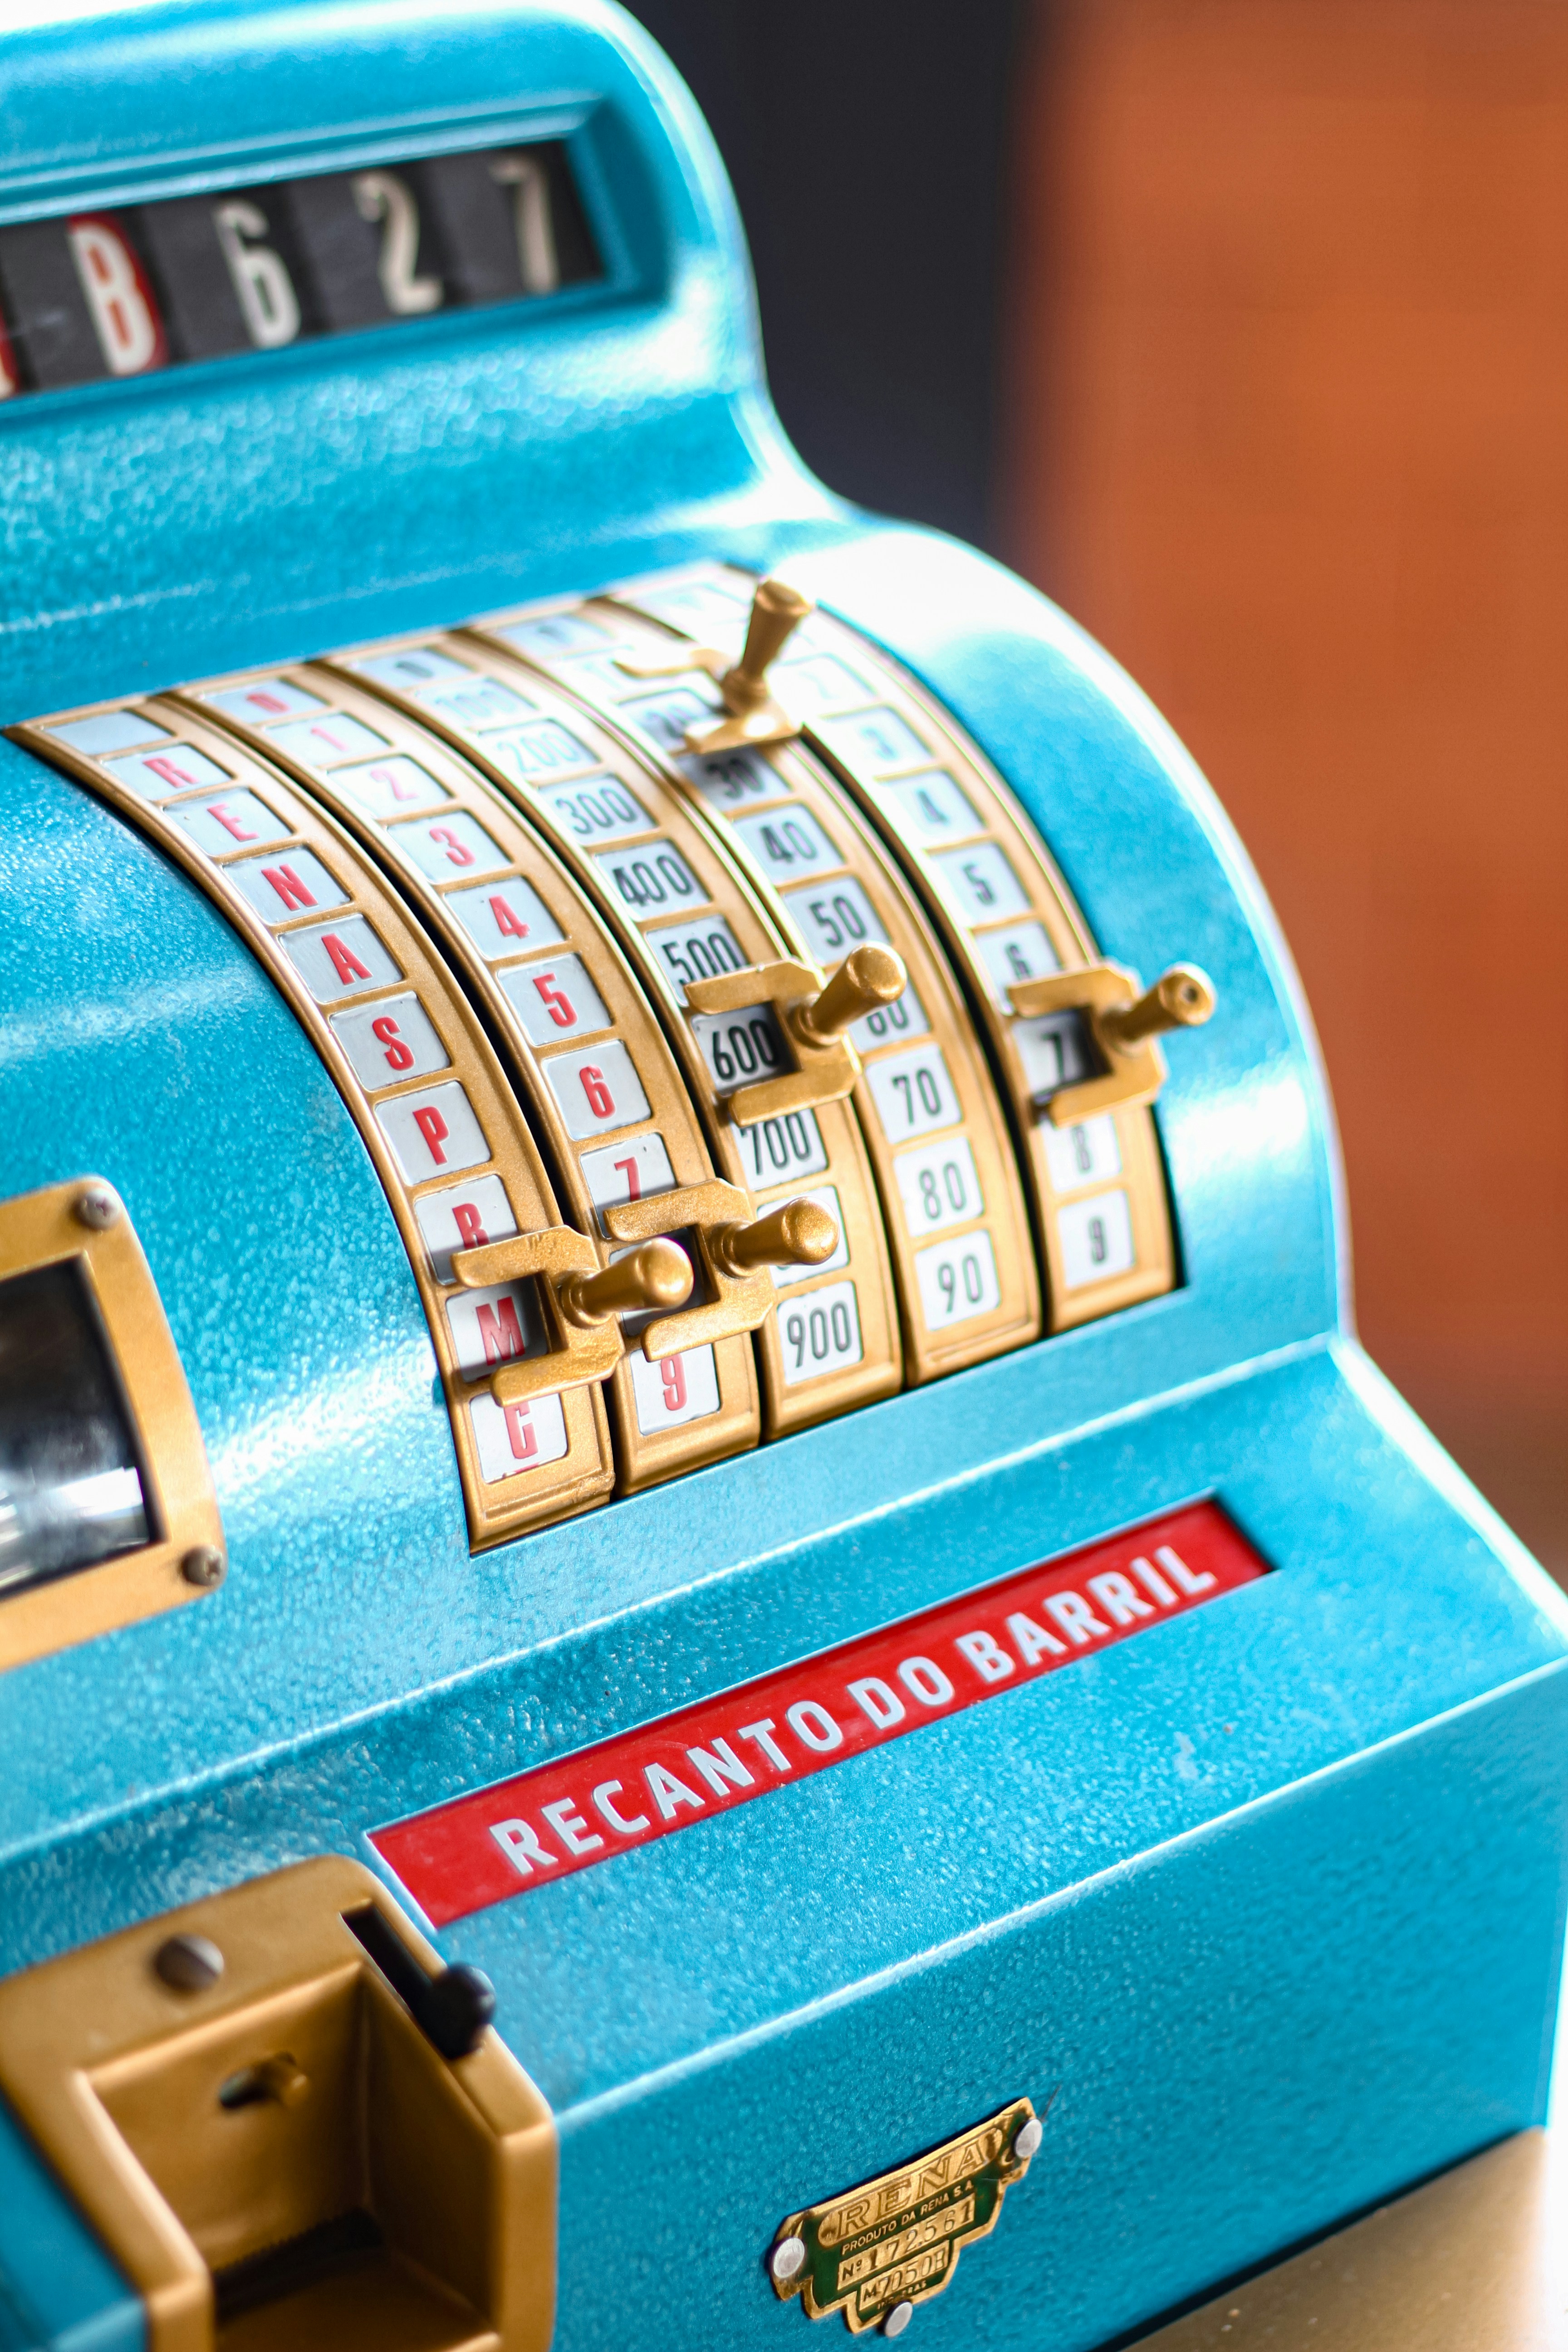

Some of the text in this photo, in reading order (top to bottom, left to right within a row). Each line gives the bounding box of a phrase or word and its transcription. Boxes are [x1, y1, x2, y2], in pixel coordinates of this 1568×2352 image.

[216, 199, 300, 348] 6
[356, 170, 443, 314] 2
[490, 154, 559, 294] 7
[311, 727, 350, 751] 1
[497, 732, 579, 775] 200
[142, 756, 201, 789] R
[370, 769, 419, 801] 2
[206, 803, 260, 843] E
[555, 787, 637, 835] 300
[917, 789, 948, 826] 4
[429, 826, 476, 867] 3
[758, 820, 819, 865] 40
[260, 863, 320, 912] N
[612, 854, 694, 905] 400
[961, 863, 995, 907] 5
[489, 895, 531, 939] 4
[808, 895, 867, 948] 50
[321, 933, 372, 985] A
[661, 931, 749, 988] 500
[533, 973, 578, 1028] 5
[372, 1016, 415, 1071] S
[711, 1018, 780, 1083] 600
[1040, 1031, 1066, 1084] 7
[579, 1065, 614, 1119] 6
[892, 1067, 942, 1127] 70
[412, 1106, 449, 1166] P
[740, 1112, 813, 1175] 700
[613, 1156, 642, 1201] 7
[917, 1161, 969, 1220] 80
[1088, 1215, 1108, 1267] 9
[936, 1252, 984, 1315] 90
[476, 1296, 525, 1366] M
[786, 1300, 853, 1369] 900
[660, 1352, 687, 1411] 9
[503, 1401, 539, 1459] C
[490, 1544, 1216, 1877] RECANTO DO BARRIL
[836, 2139, 988, 2239] RENA
[842, 2220, 897, 2255] PRODUTO
[901, 2210, 916, 2225] DA
[920, 2192, 950, 2216] RENA
